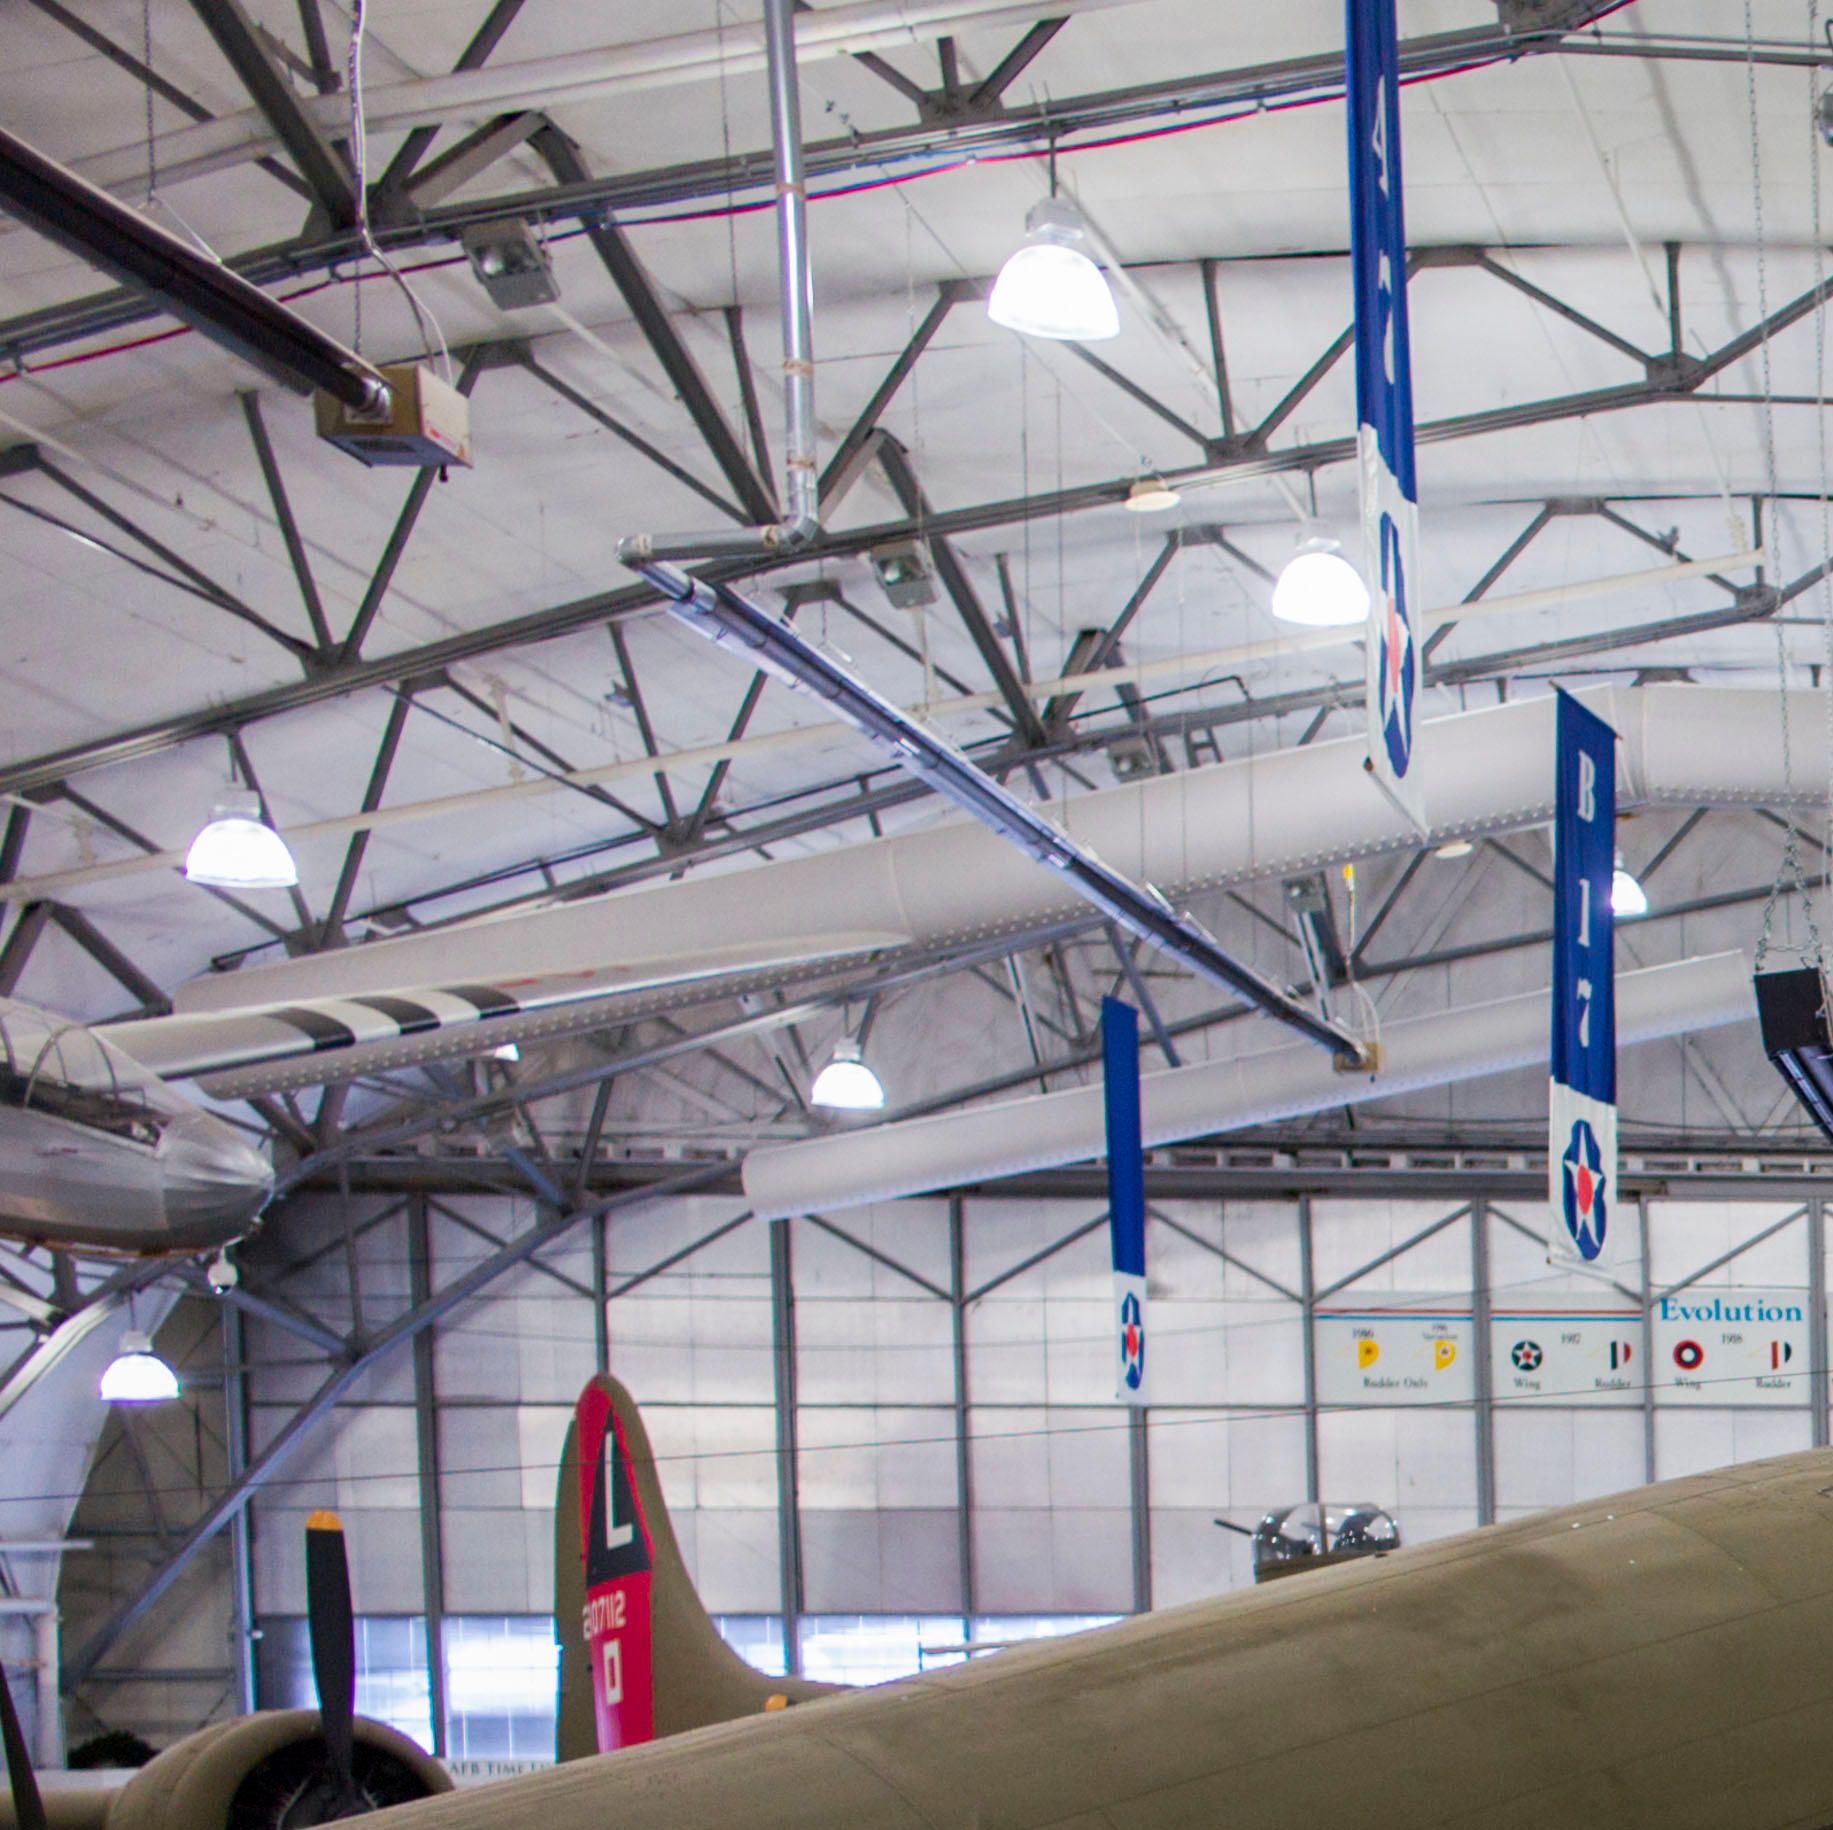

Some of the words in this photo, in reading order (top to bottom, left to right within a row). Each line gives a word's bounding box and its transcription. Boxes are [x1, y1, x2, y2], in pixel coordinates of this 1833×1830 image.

[1577, 750, 1596, 823] B
[1660, 1297, 1803, 1322] Evolution
[1514, 1377, 1541, 1390] Wing
[1595, 1377, 1632, 1389] Rudder
[1675, 1377, 1701, 1389] Wing
[1756, 1376, 1792, 1389] Rudder
[604, 1430, 633, 1550] L
